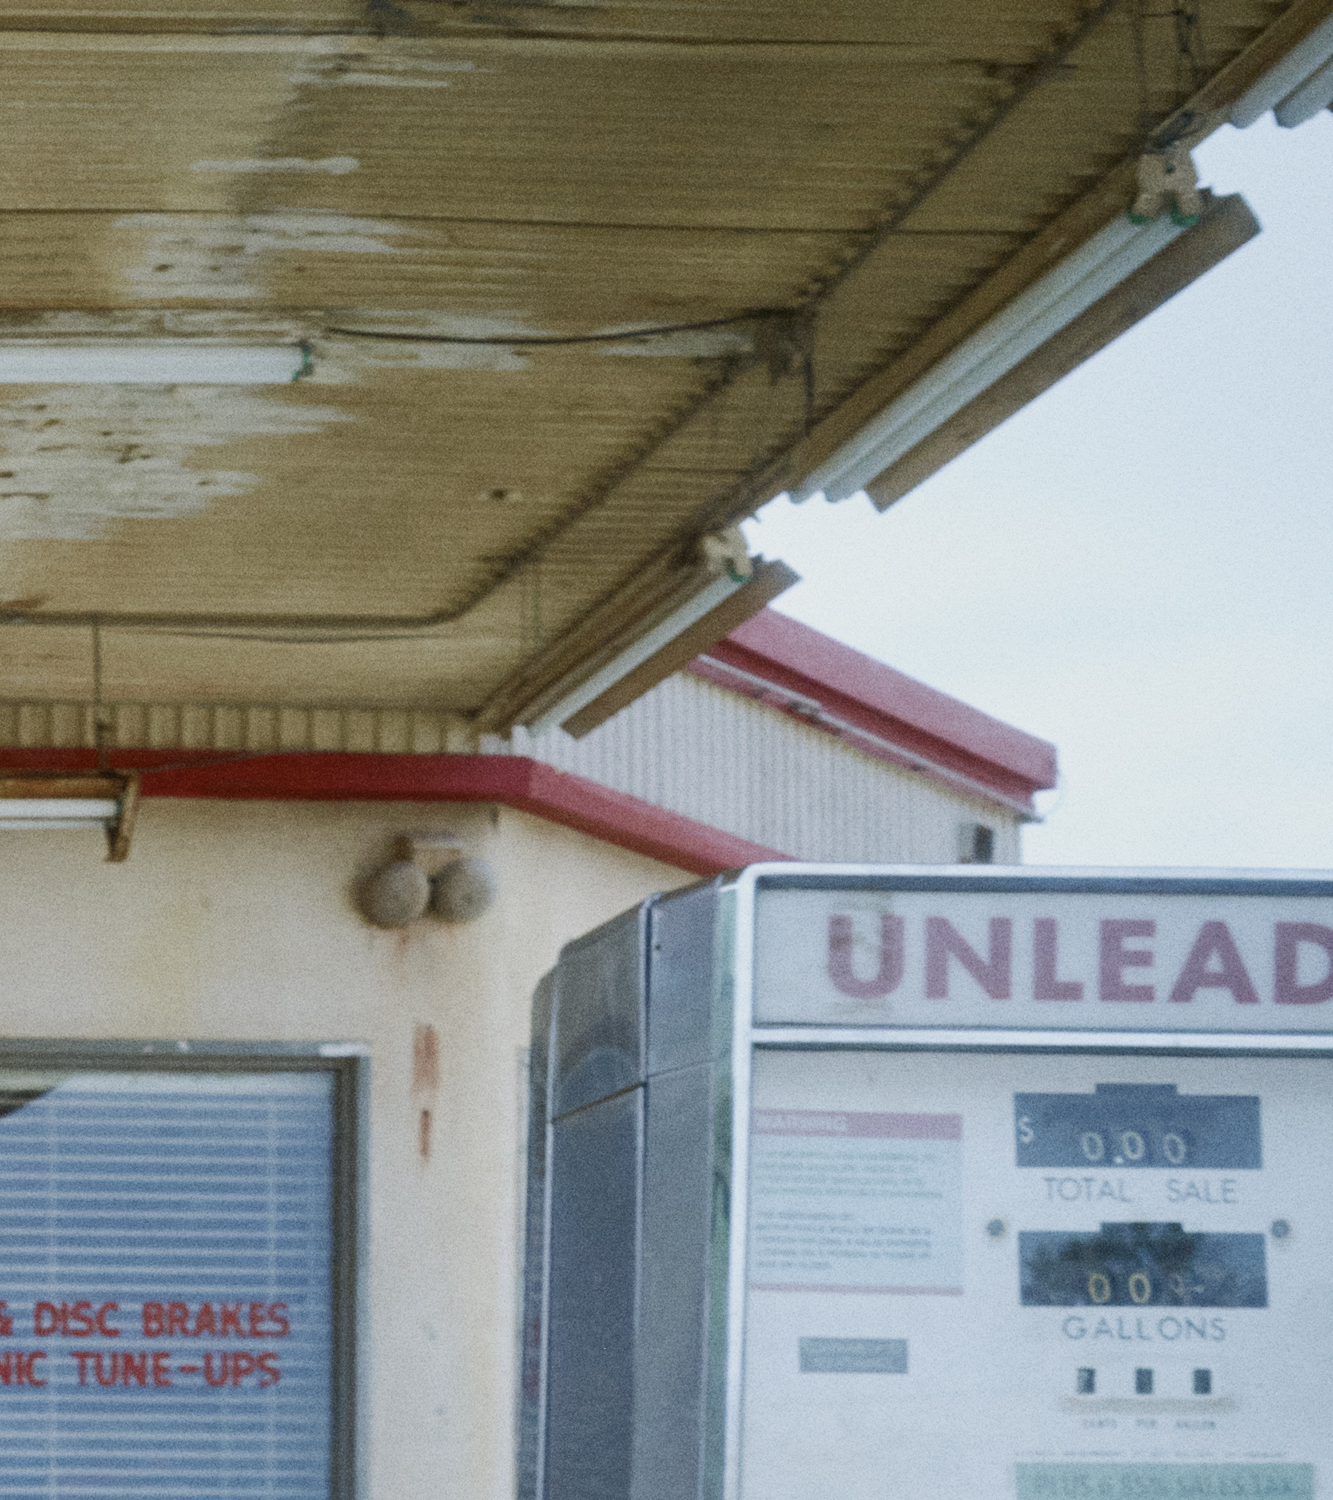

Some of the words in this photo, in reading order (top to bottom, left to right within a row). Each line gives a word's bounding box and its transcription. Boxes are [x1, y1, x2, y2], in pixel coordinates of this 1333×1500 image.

[827, 914, 1333, 1005] UNLEAD
[1018, 1115, 1035, 1144] $
[1043, 1176, 1135, 1203] TOTAL
[1166, 1177, 1239, 1204] SALE
[34, 1300, 120, 1338] DISC
[142, 1301, 290, 1338] BRAKES
[1061, 1315, 1227, 1342] GALLONS
[71, 1351, 281, 1389] TUNE-UPS
